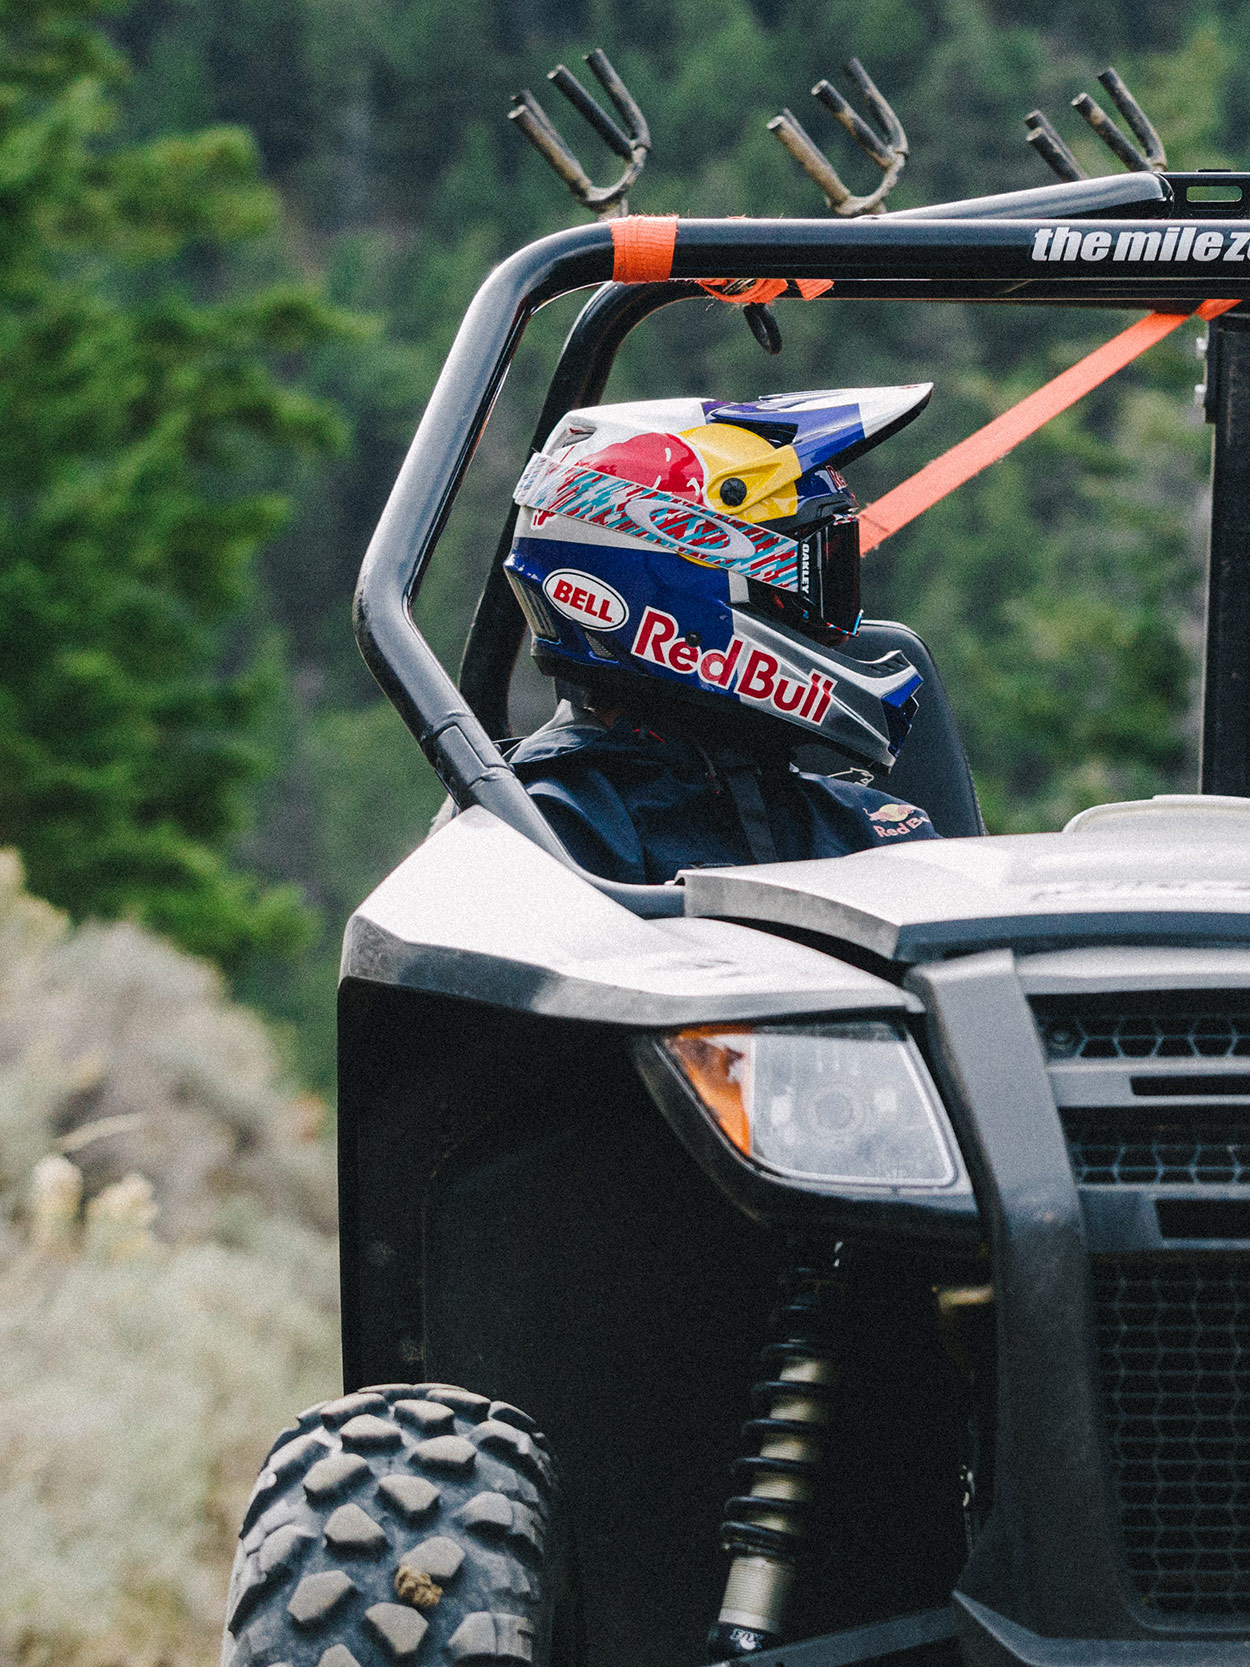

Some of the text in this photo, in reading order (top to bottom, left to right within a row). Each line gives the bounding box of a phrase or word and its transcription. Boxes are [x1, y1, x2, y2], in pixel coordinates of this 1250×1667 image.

[801, 543, 810, 594] OAKLEY
[552, 579, 613, 622] BELL
[632, 606, 837, 726] Red Bull
[873, 822, 911, 838] Red
